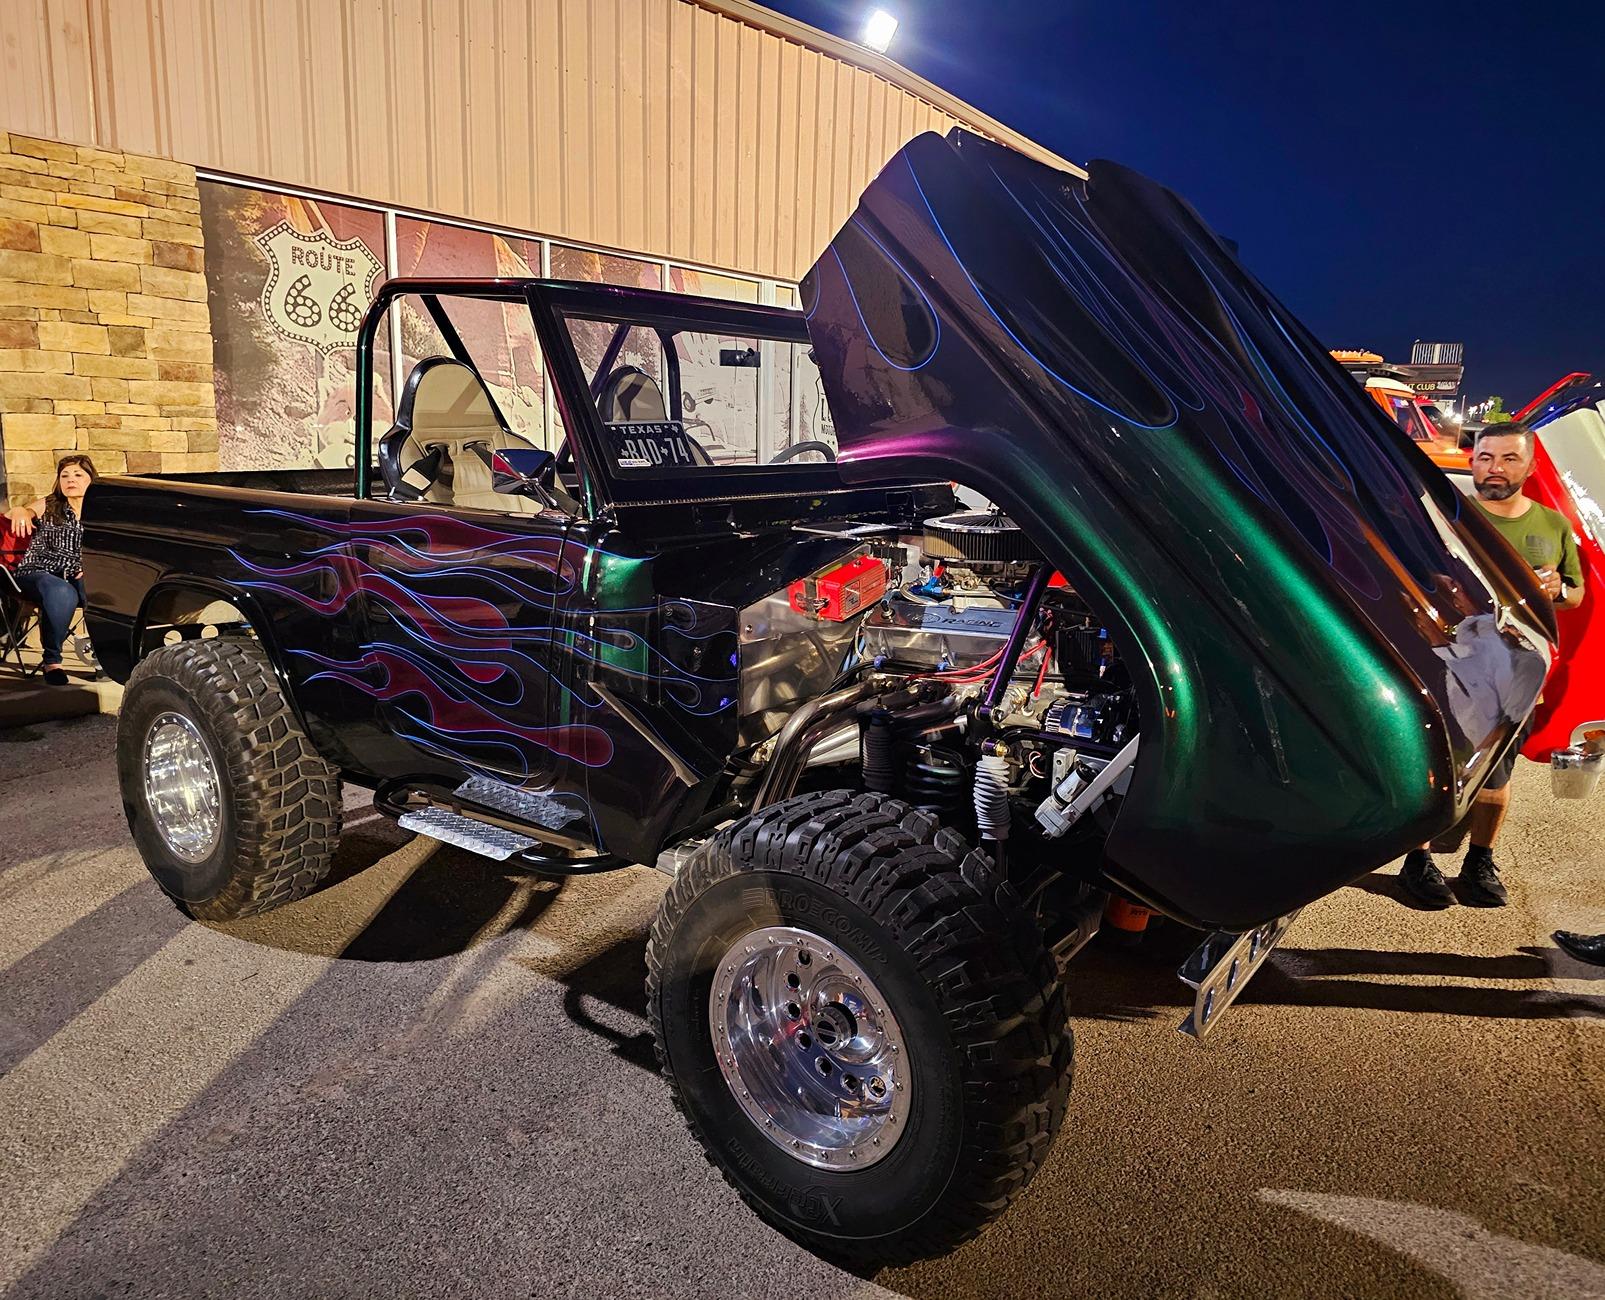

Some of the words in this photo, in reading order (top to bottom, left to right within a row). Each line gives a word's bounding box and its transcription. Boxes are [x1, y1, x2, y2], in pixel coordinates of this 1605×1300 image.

[291, 246, 356, 276] ROUTE
[284, 274, 363, 333] 66
[620, 425, 662, 435] TEXAS
